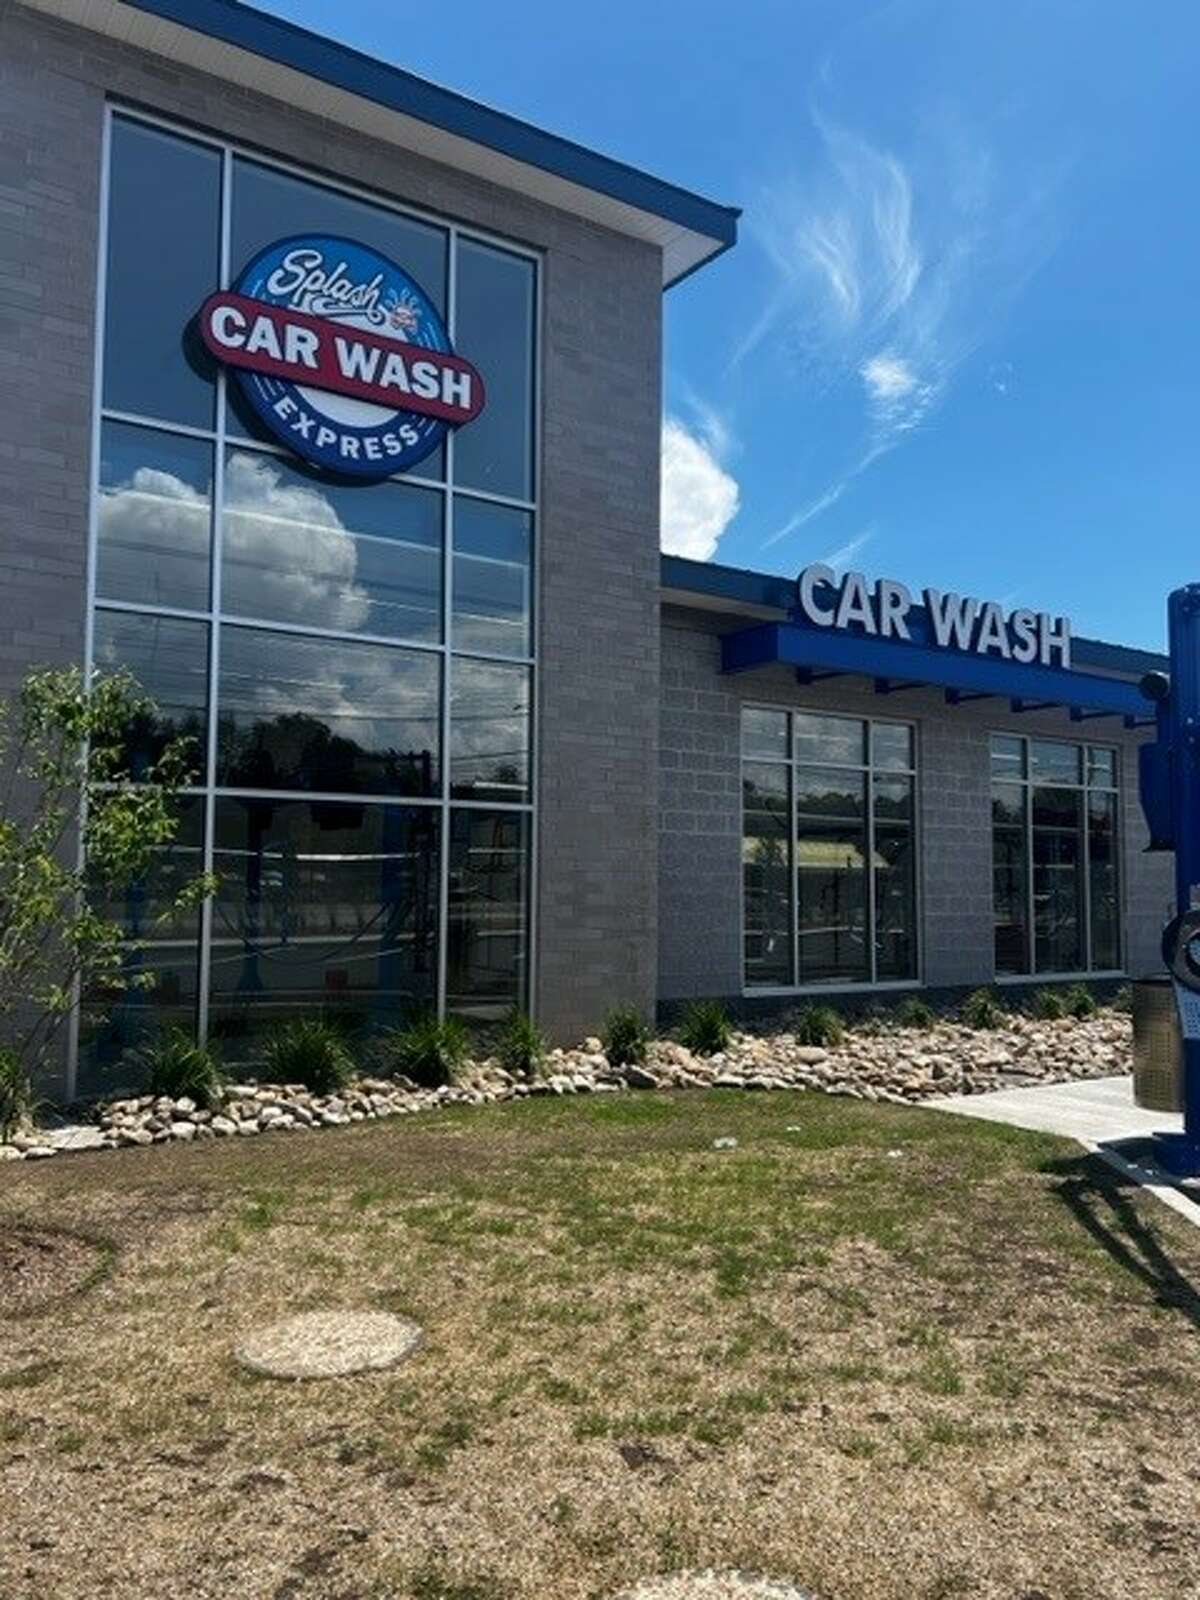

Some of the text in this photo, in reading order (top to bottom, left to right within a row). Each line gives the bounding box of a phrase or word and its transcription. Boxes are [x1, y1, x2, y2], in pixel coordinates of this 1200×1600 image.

[267, 249, 386, 322] Splash
[210, 306, 472, 409] CAR WASH
[272, 395, 419, 460] EXPRESS
[800, 562, 1072, 669] CAR WASH
